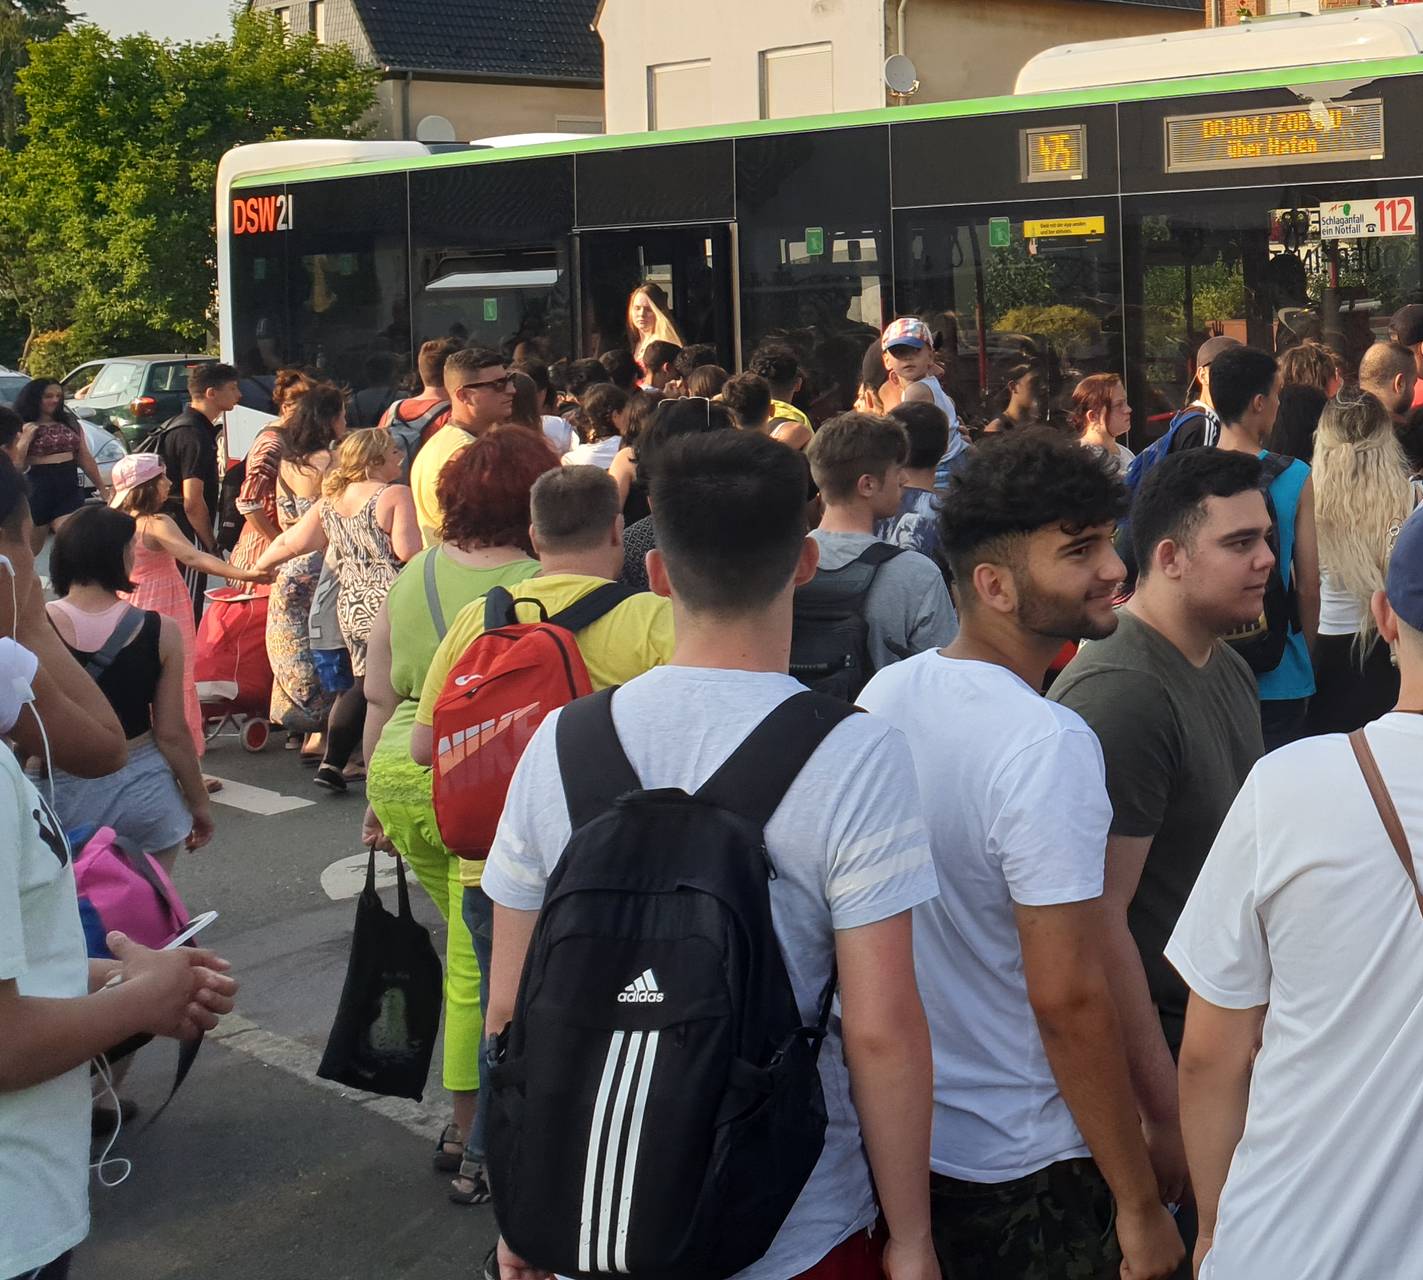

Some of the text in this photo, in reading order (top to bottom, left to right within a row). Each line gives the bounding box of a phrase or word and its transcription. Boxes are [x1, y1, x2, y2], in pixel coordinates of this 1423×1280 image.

[1039, 133, 1072, 171] 475
[1227, 135, 1318, 158] über Hafen
[233, 194, 293, 235] DSW21
[1321, 213, 1365, 227] Schlaganfall
[1375, 198, 1413, 233] 112
[1321, 226, 1361, 236] ein Notfall
[617, 990, 665, 1003] adidas
